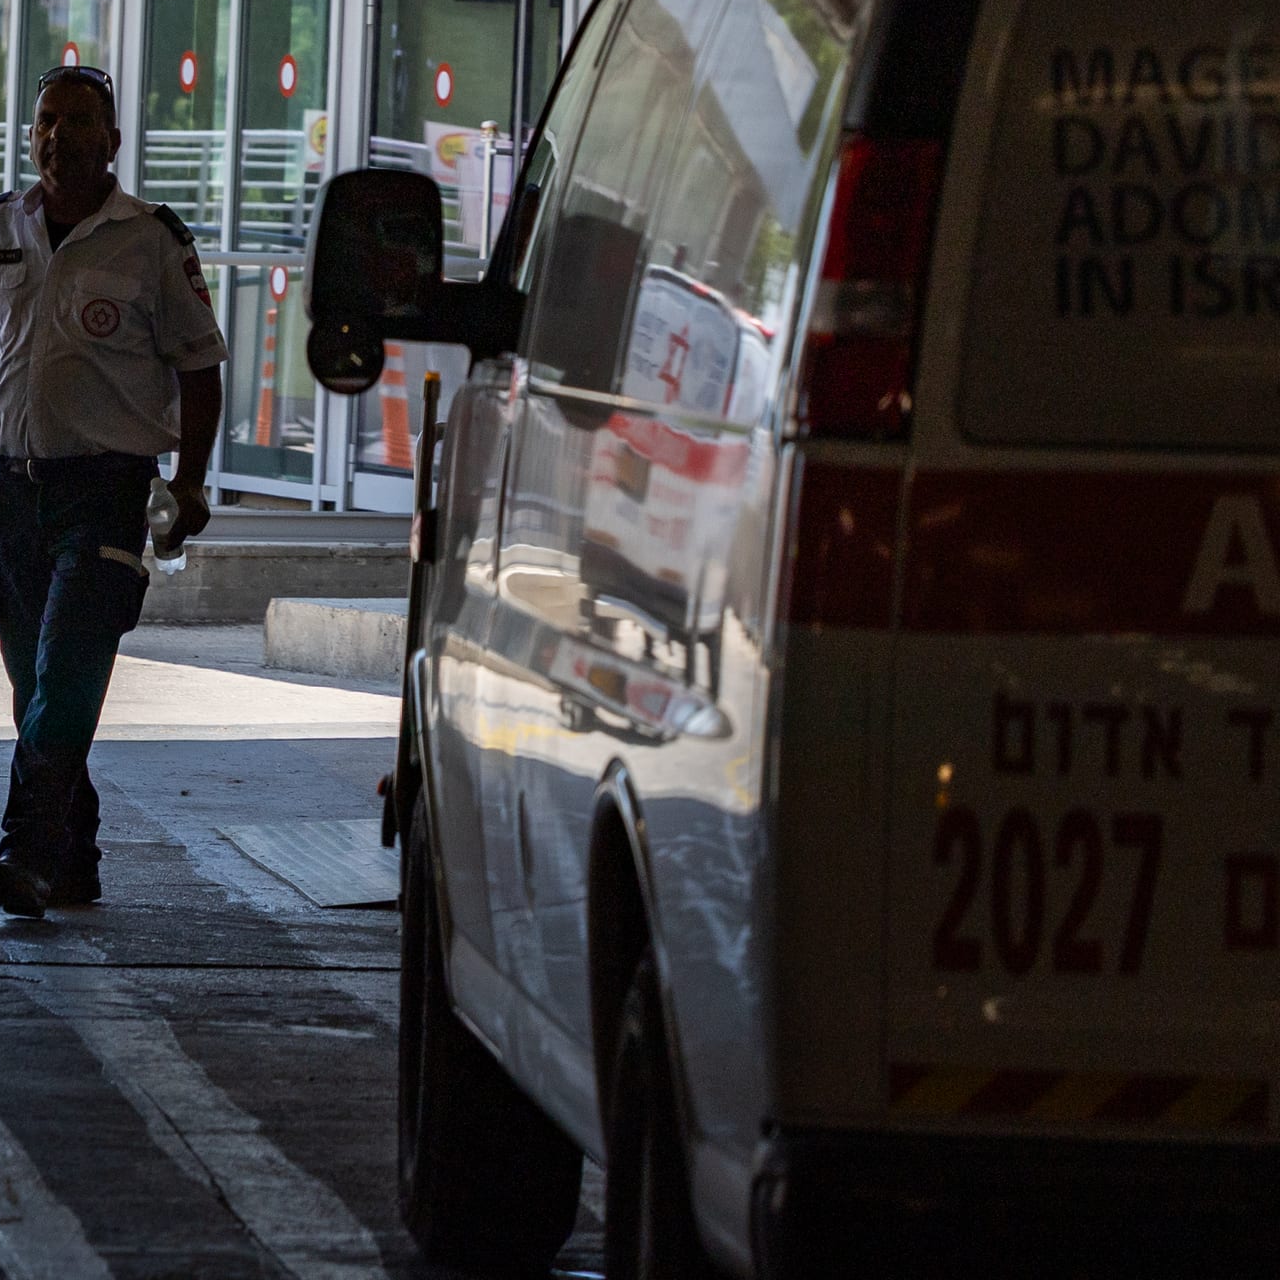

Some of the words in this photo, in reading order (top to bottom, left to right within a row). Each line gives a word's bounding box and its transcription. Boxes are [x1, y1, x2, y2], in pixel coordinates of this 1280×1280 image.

[1056, 252, 1136, 318] IN
[993, 694, 1184, 779] אדום
[932, 804, 1164, 974] 2027
